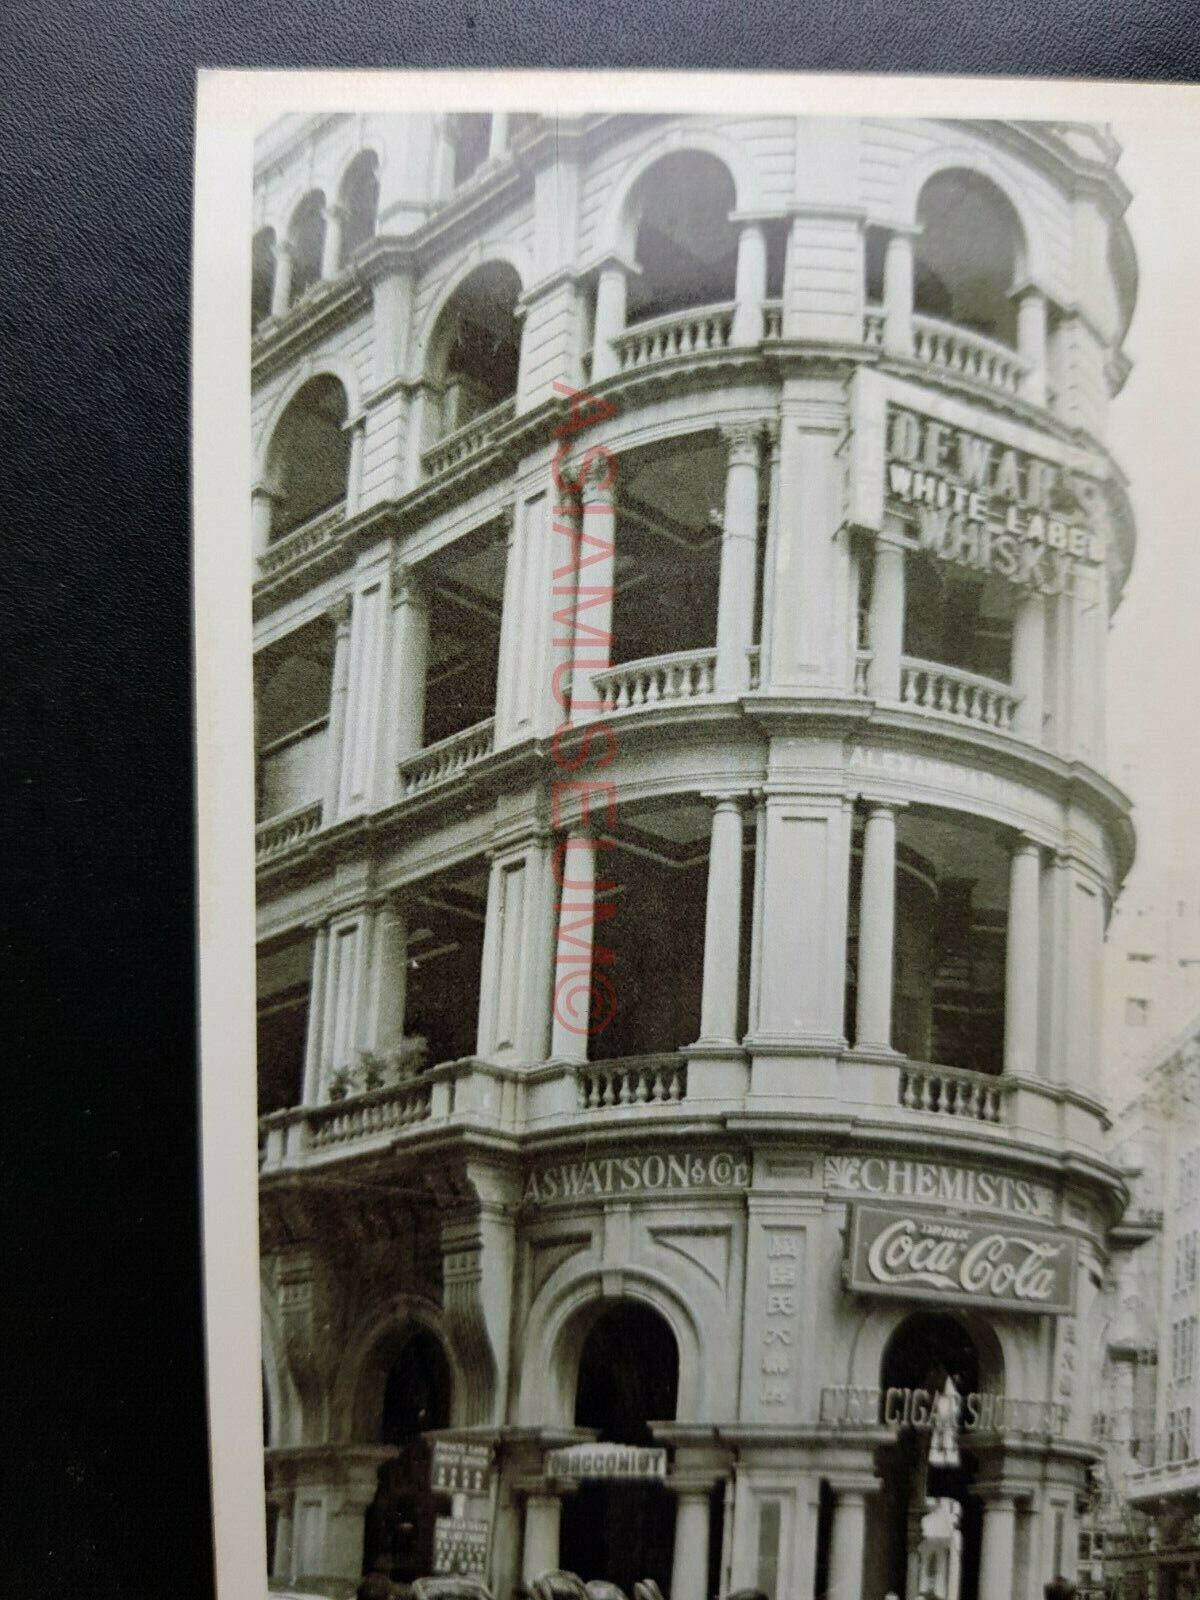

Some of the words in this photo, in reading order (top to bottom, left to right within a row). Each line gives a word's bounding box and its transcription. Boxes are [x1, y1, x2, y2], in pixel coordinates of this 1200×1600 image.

[889, 462, 988, 524] WHITE
[1006, 503, 1106, 563] LABEL
[918, 506, 1073, 596] WHISKY
[859, 1157, 1034, 1214] CHEMISTS
